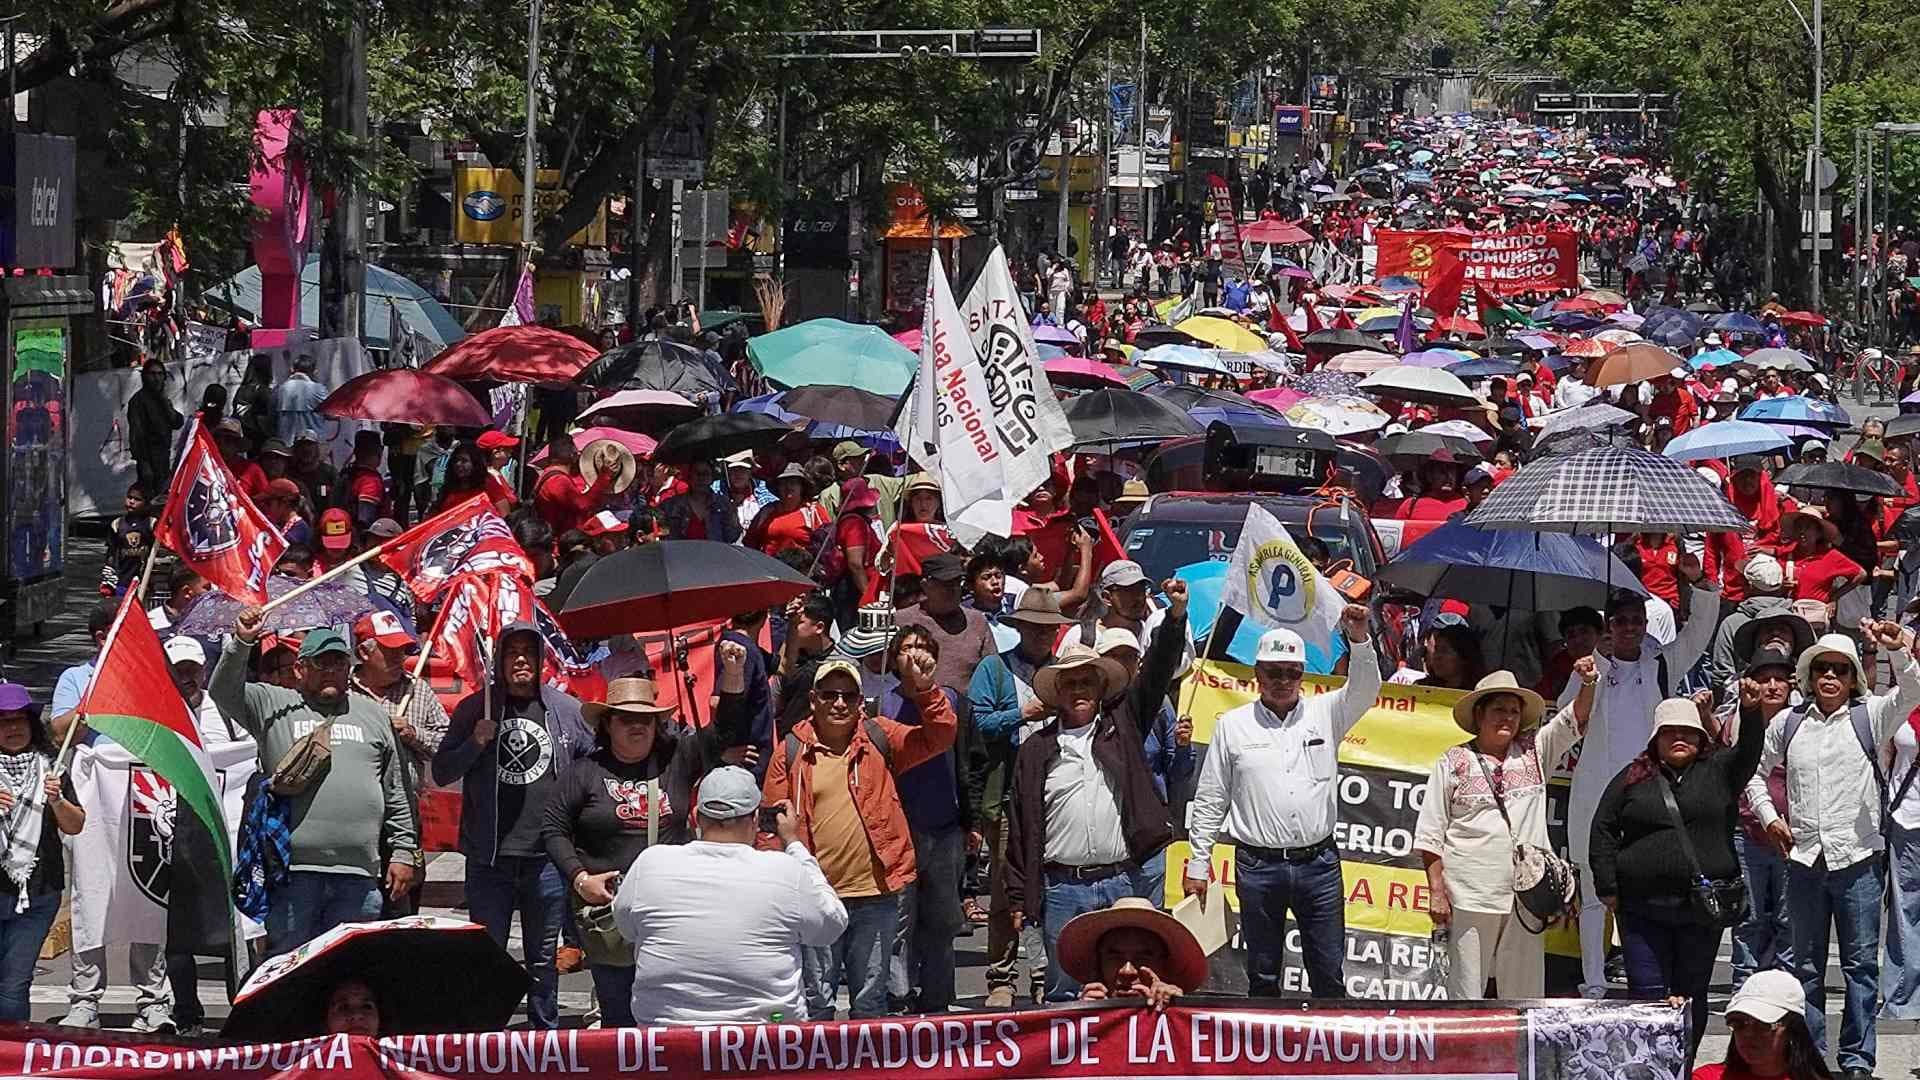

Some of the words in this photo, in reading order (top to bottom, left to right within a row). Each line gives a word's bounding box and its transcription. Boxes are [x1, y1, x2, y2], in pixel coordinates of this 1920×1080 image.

[31, 176, 60, 226] telcel
[1471, 235, 1548, 250] PARTIDO
[1464, 265, 1486, 279] DE
[944, 367, 999, 464] Nacional
[1333, 821, 1413, 857] ERIO
[1346, 937, 1384, 965] LA
[379, 1029, 591, 1073] NACIONAL
[617, 1027, 669, 1072] DE
[694, 1019, 1021, 1071] TRABAJADORES
[1049, 1016, 1100, 1065] DE
[1128, 1013, 1176, 1063] LA
[1191, 1009, 1435, 1063] EDUCACIÓN
